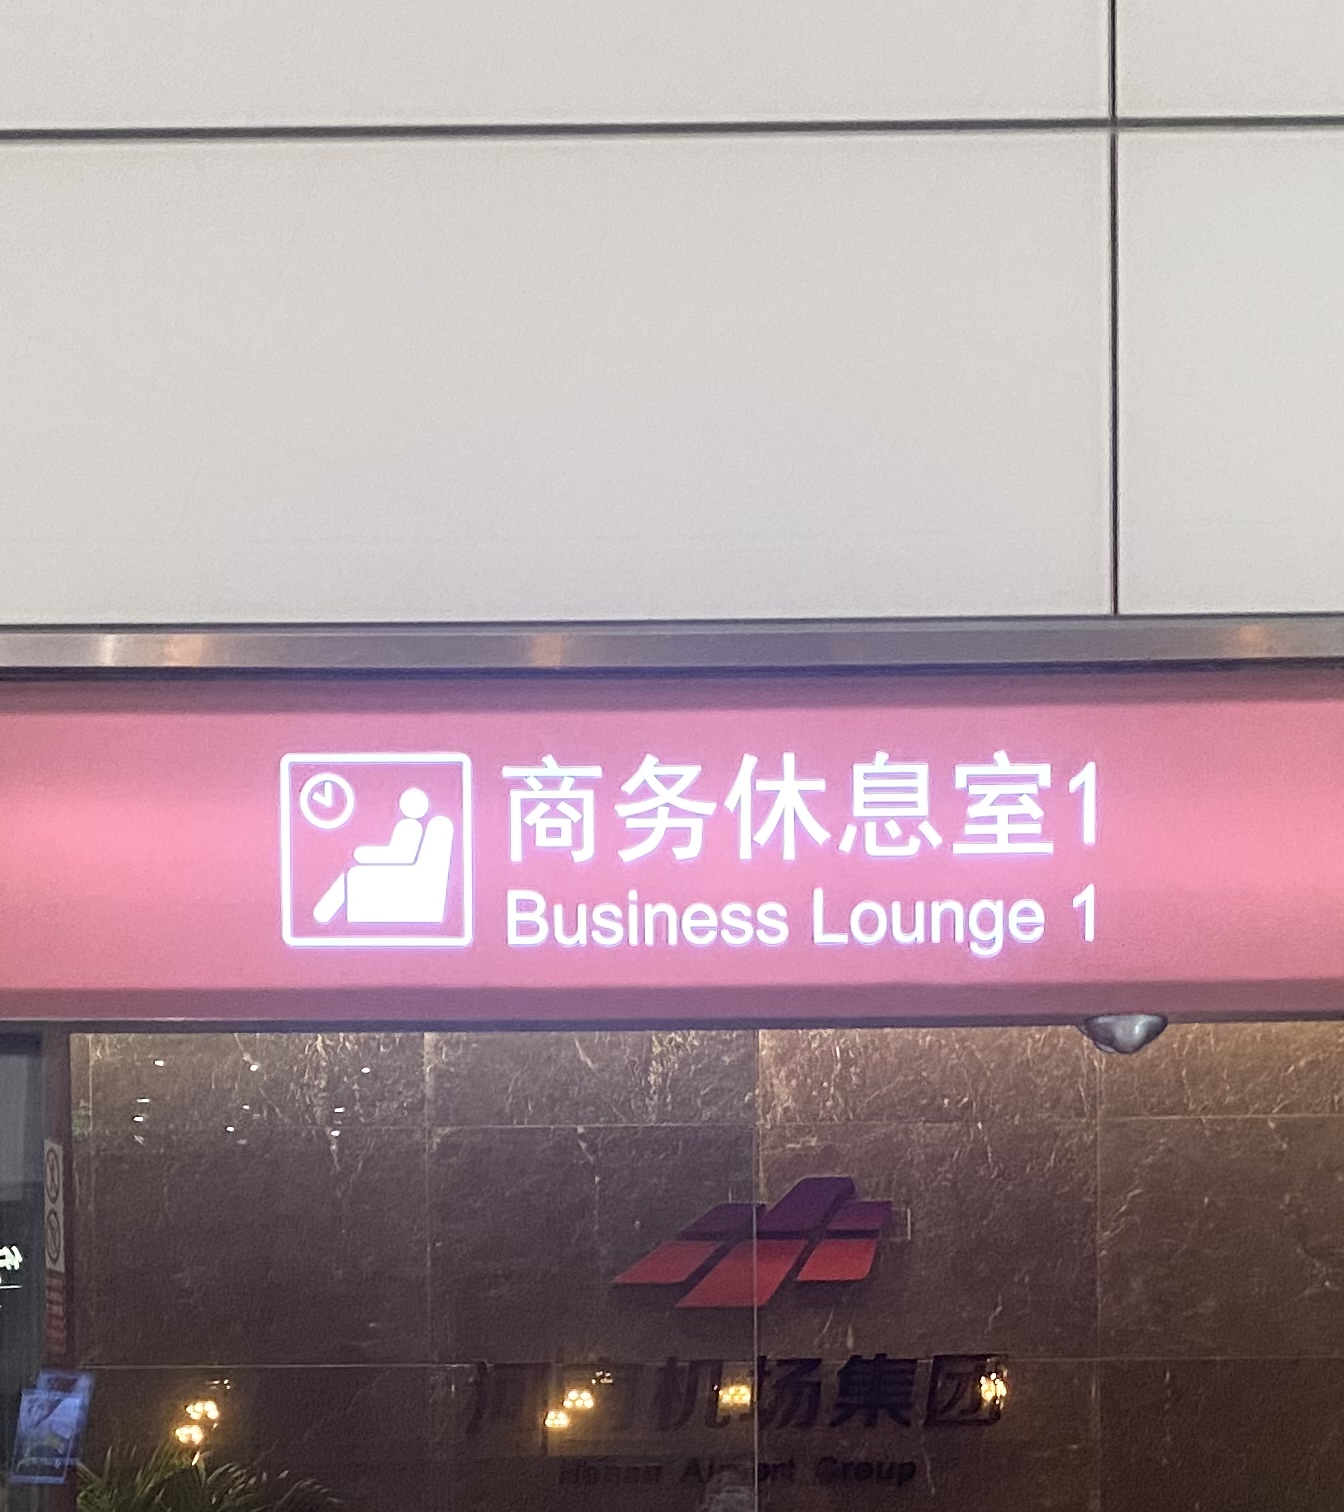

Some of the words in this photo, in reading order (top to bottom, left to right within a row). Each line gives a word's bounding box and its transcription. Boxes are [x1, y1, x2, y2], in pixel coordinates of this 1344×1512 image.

[501, 750, 1101, 863] 商务休息室1
[505, 889, 791, 947] Business
[812, 889, 1046, 957] Lounge
[1072, 886, 1097, 940] 1
[680, 1458, 795, 1488] Airort
[819, 1457, 918, 1487] Group
